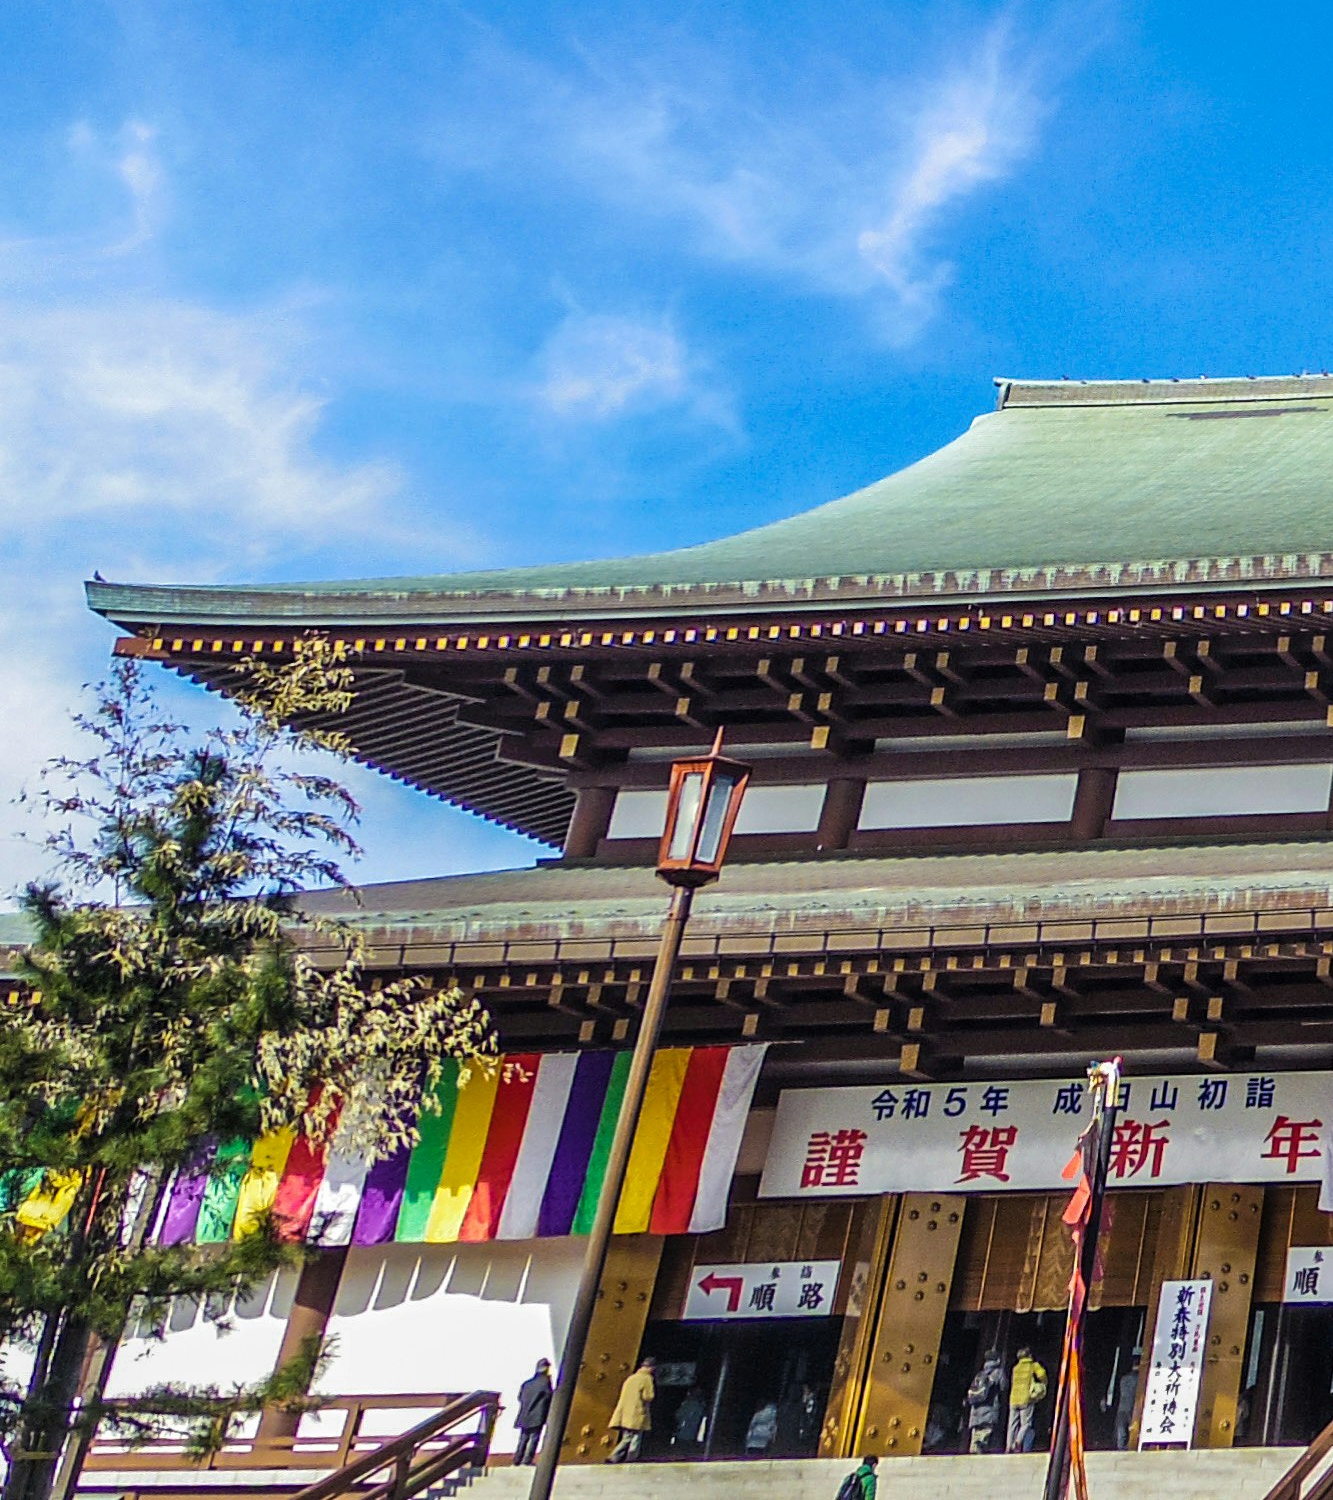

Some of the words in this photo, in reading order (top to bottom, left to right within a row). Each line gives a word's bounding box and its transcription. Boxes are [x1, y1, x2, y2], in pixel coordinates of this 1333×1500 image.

[870, 1086, 1011, 1122] 令和5年
[800, 1115, 1324, 1189] 謹賀新年
[749, 1281, 825, 1311] 順路
